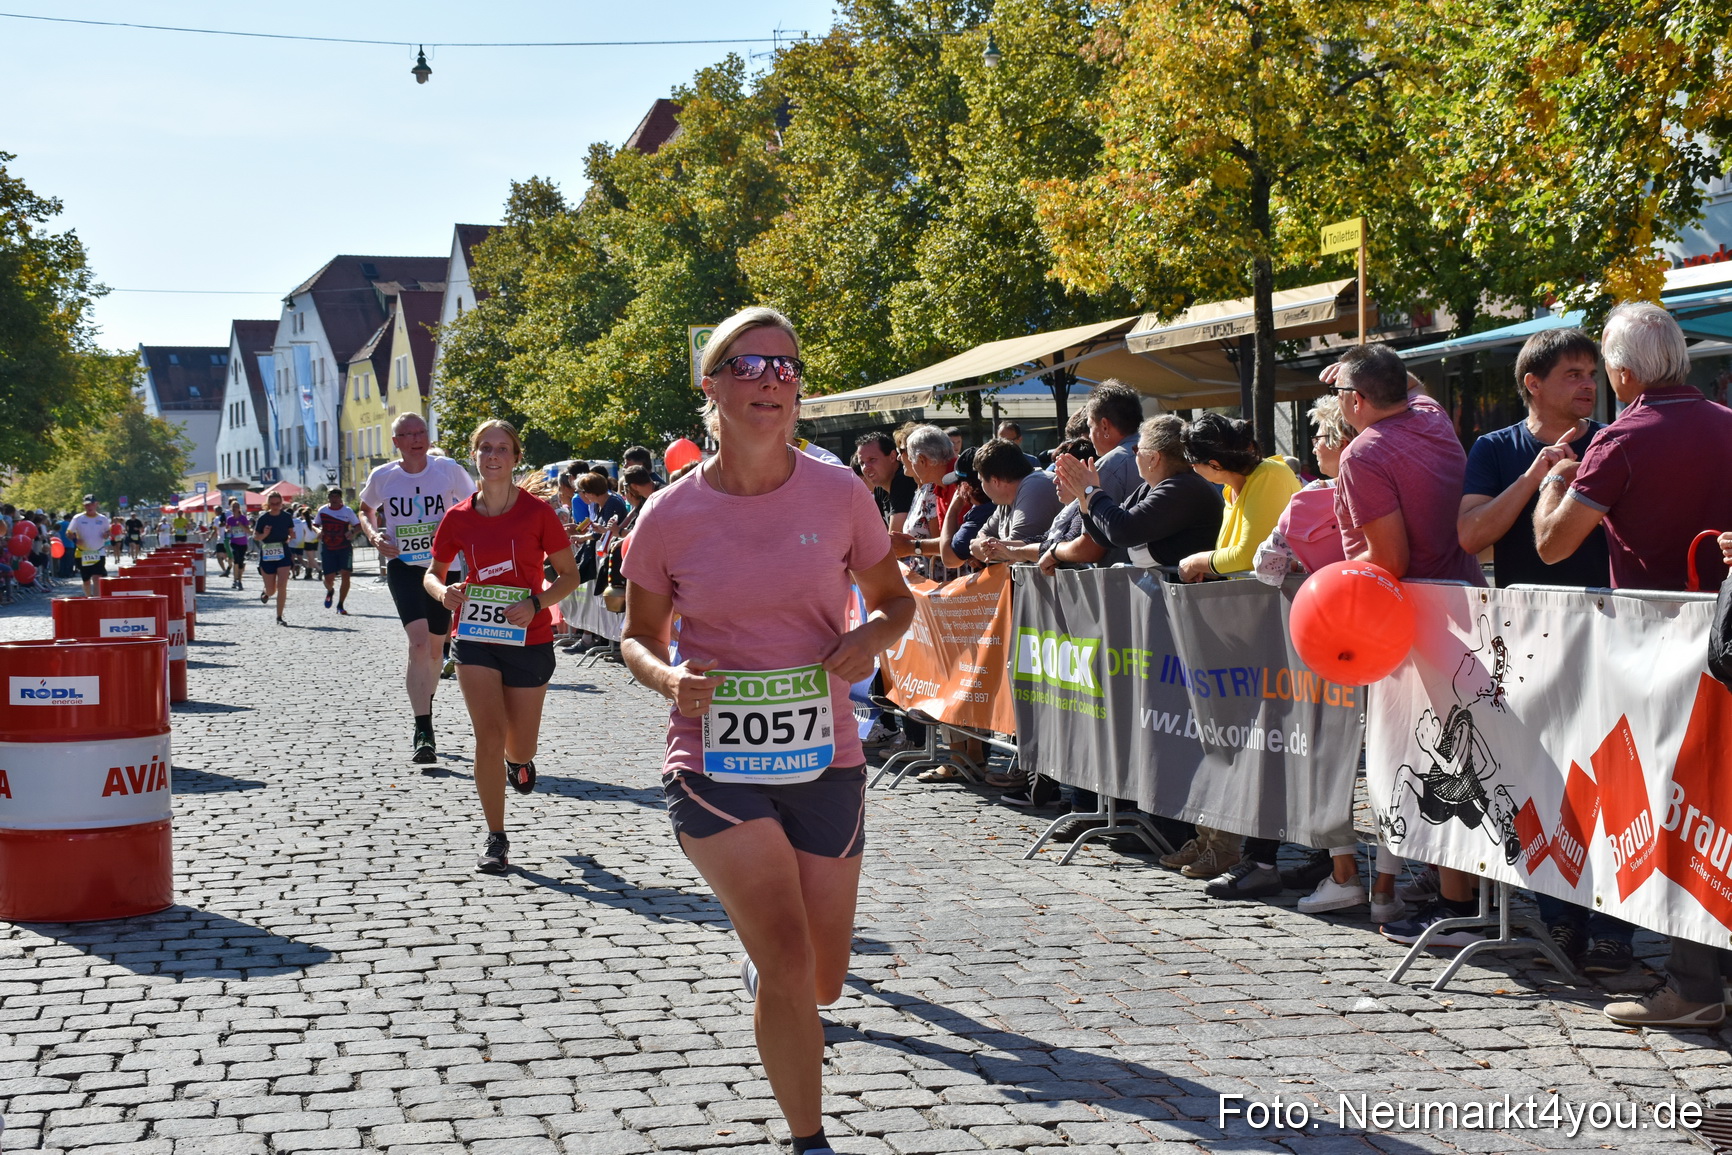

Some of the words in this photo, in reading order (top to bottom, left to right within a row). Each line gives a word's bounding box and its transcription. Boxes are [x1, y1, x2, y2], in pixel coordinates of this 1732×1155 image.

[398, 524, 437, 537] BOCK
[470, 586, 523, 603] BOCK
[468, 603, 517, 626] 258
[469, 626, 514, 639] CARMEN
[1018, 634, 1095, 689] BOCK
[715, 674, 815, 698] BOCK
[901, 672, 941, 699] Agentur
[718, 706, 818, 746] 2057
[723, 752, 819, 771] STEFANIE
[1553, 811, 1585, 868] Braun
[1608, 809, 1652, 874] Braun
[1689, 856, 1711, 882] Sicher
[1710, 875, 1722, 891] ist
[1720, 887, 1732, 903] sic
